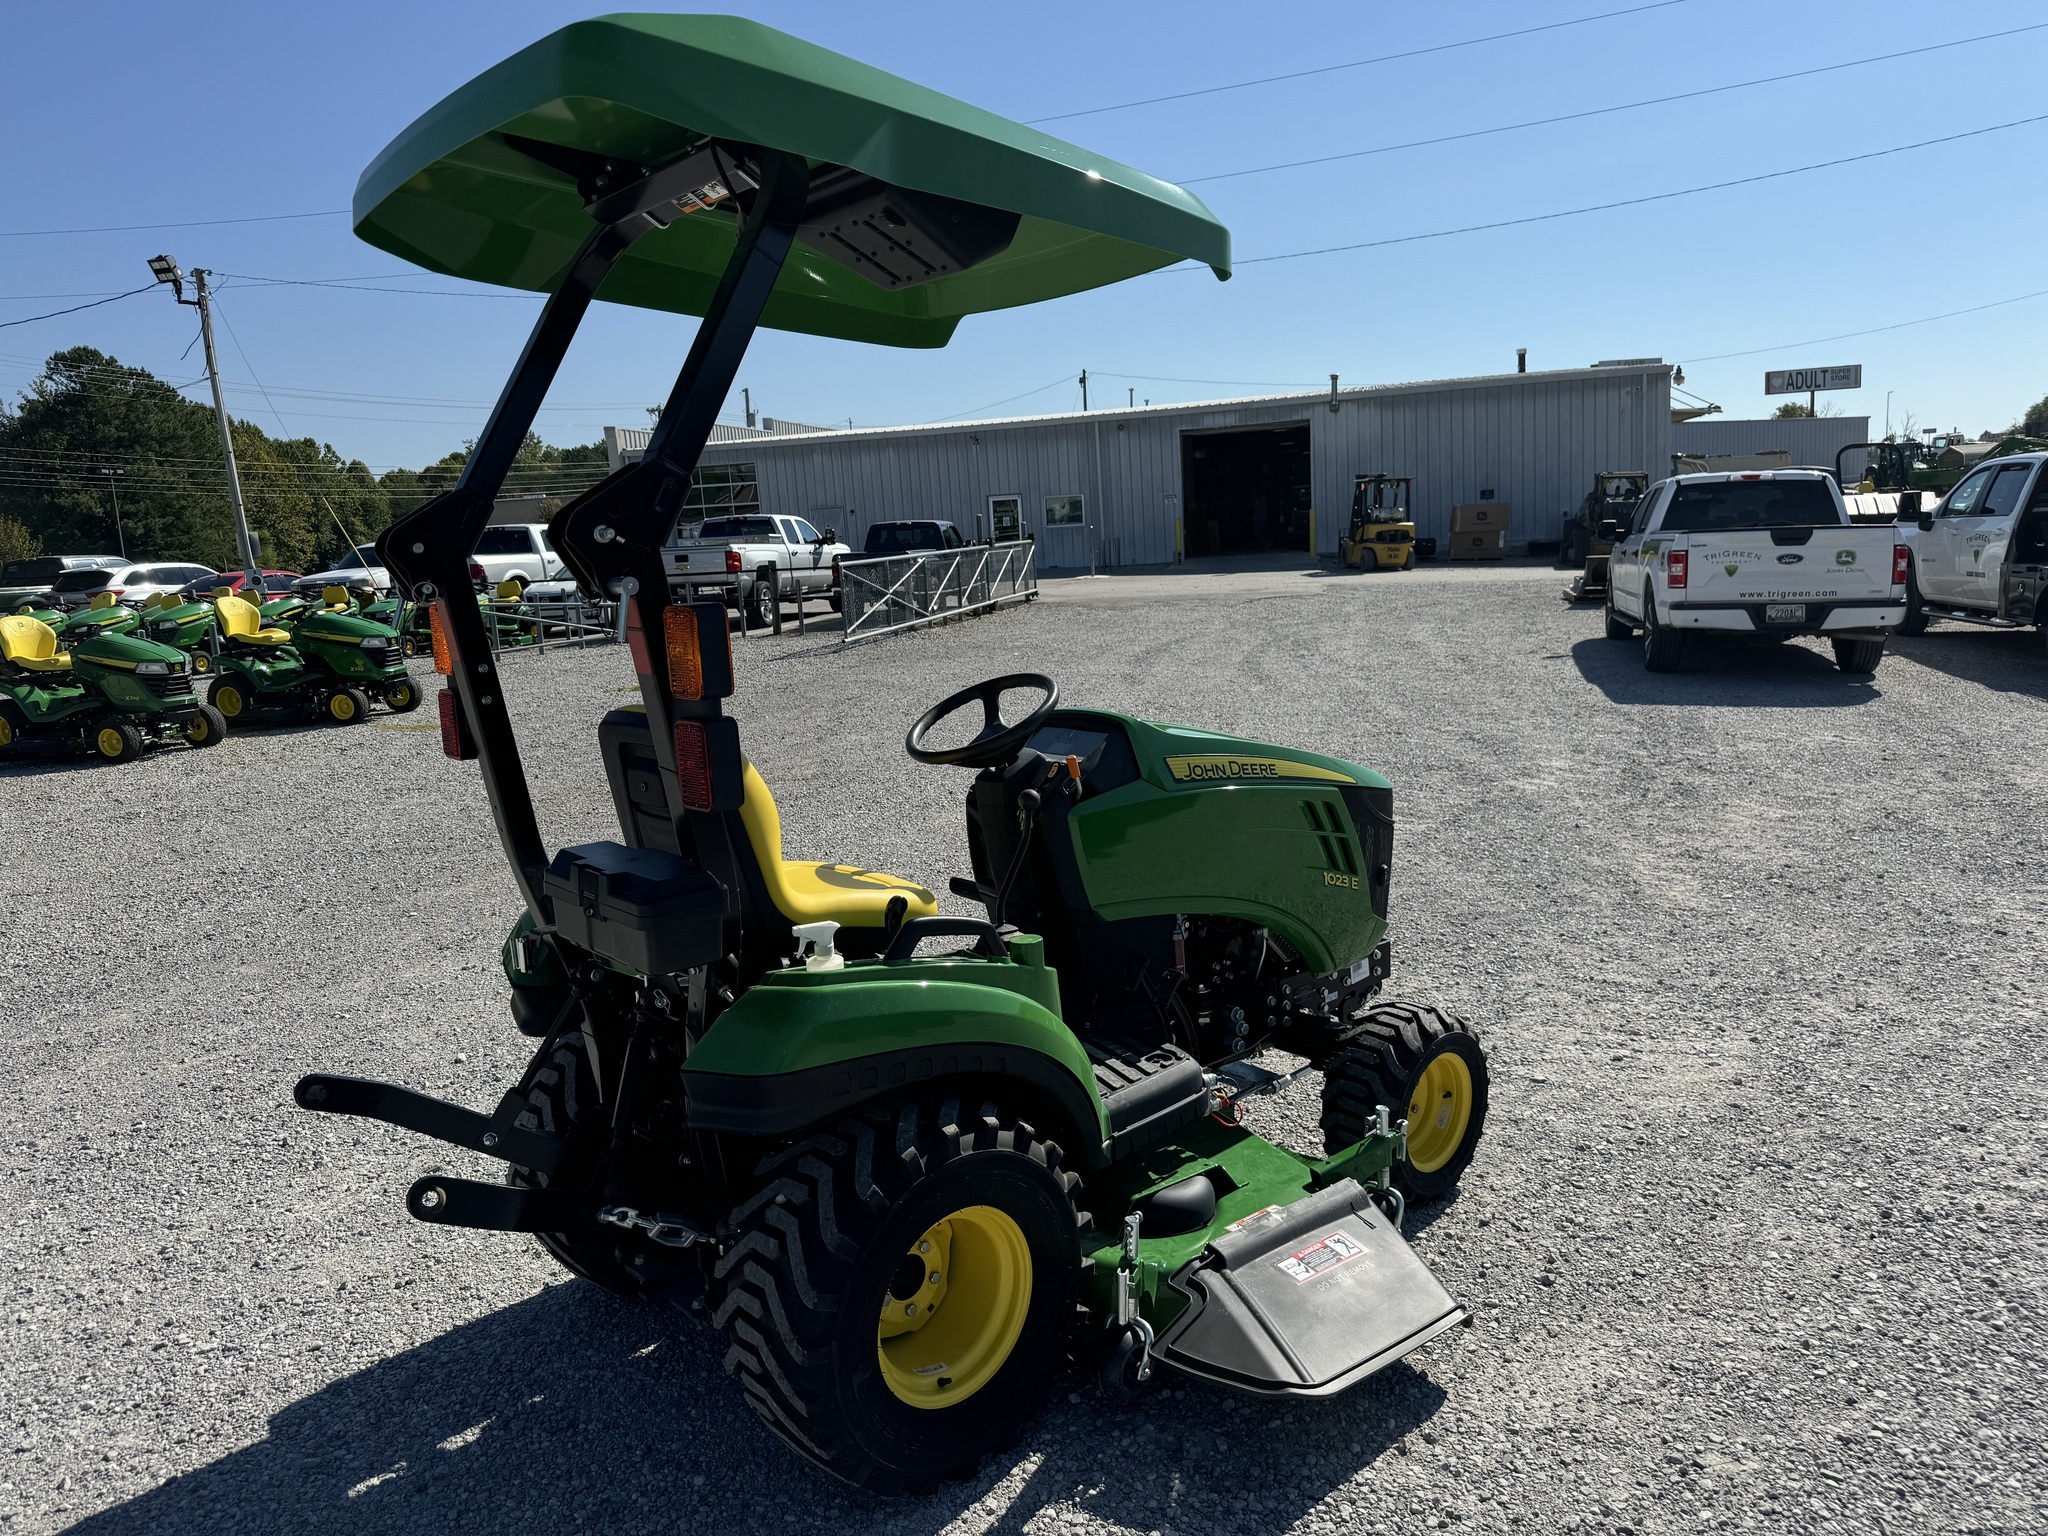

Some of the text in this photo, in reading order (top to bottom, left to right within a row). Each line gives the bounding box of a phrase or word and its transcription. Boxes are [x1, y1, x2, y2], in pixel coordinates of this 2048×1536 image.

[1786, 370, 1828, 391] ADULT
[1703, 550, 1761, 561] TRIGREEN
[1740, 589, 1837, 598] www.trigreen.com
[1183, 761, 1278, 779] JOHN DEERE
[1323, 872, 1359, 890] 1023 E
[1317, 1260, 1374, 1291] DO NOT REMOVE
